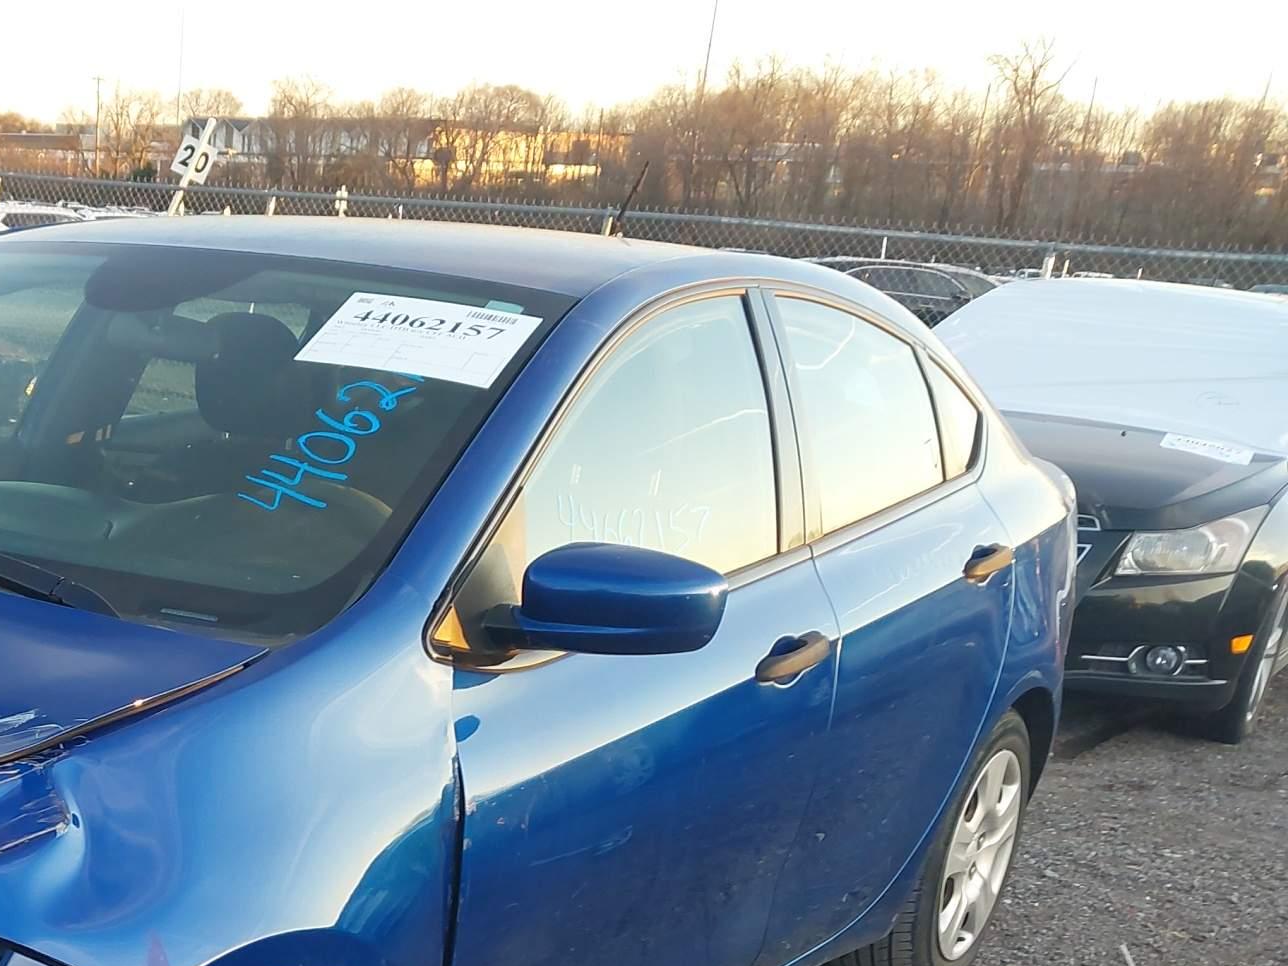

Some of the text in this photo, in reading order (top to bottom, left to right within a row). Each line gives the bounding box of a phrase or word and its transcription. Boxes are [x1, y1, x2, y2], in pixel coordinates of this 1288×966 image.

[178, 144, 210, 174] 20
[353, 309, 506, 341] 44062157
[237, 373, 424, 511] 44062
